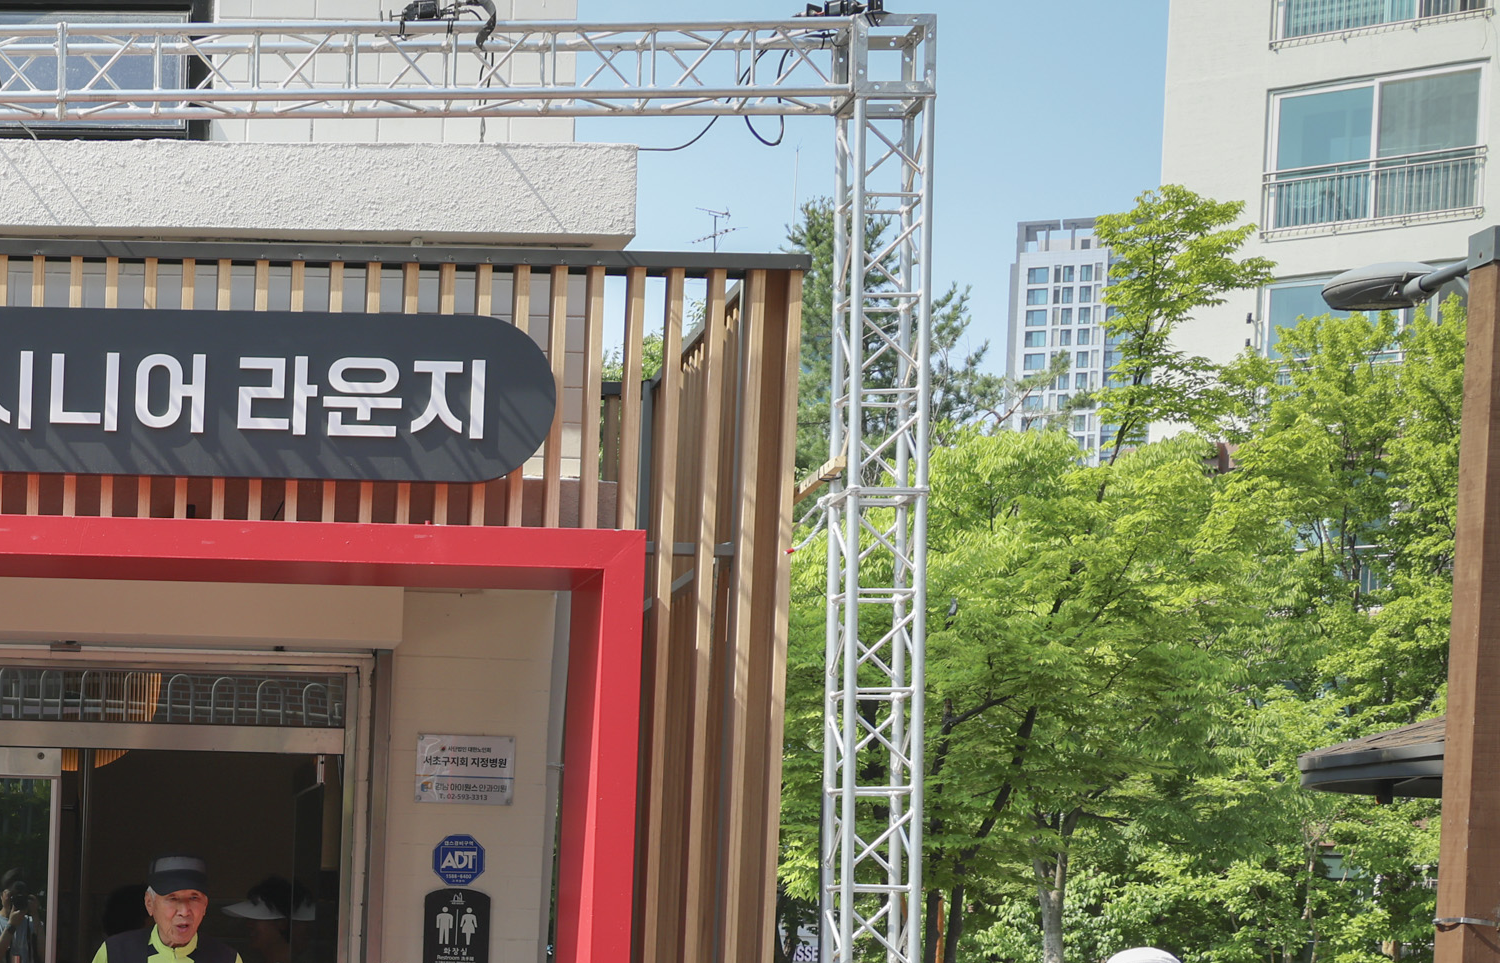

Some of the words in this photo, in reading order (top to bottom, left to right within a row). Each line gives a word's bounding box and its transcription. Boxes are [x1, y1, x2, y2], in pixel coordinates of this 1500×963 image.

[236, 355, 487, 440] 라운지
[423, 756, 468, 767] 서초구지회
[471, 757, 507, 769] 지정병원
[441, 850, 477, 869] ADT
